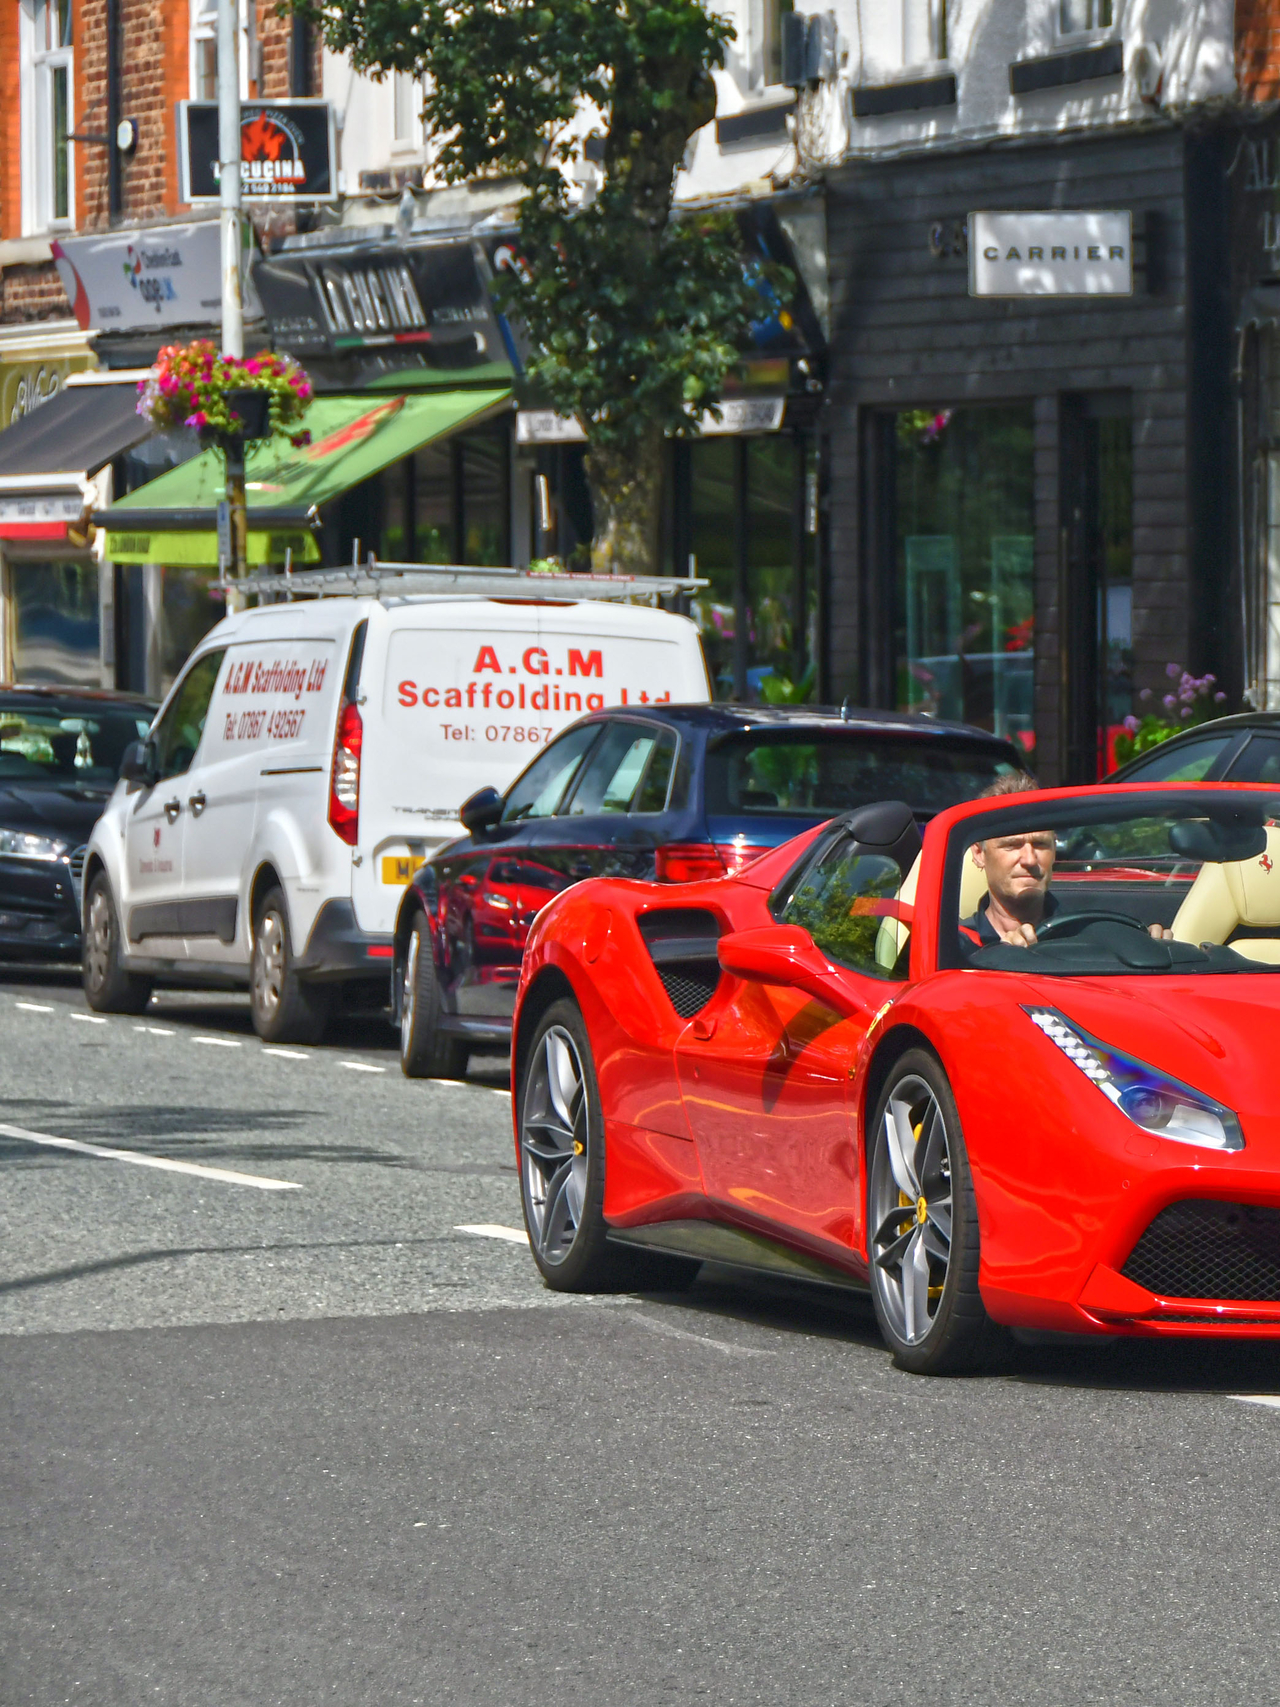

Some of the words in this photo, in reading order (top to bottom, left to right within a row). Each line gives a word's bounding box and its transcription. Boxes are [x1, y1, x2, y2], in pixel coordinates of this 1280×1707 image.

[240, 159, 306, 179] CUCINA
[983, 246, 1125, 260] CARRIER
[473, 645, 603, 678] A.G.M
[223, 661, 255, 694] A.G.M
[251, 659, 307, 701] Scaffolding
[306, 657, 329, 692] Ltd
[398, 680, 604, 712] Scaffolding
[440, 724, 475, 741] Tel:
[485, 725, 553, 743] 07867
